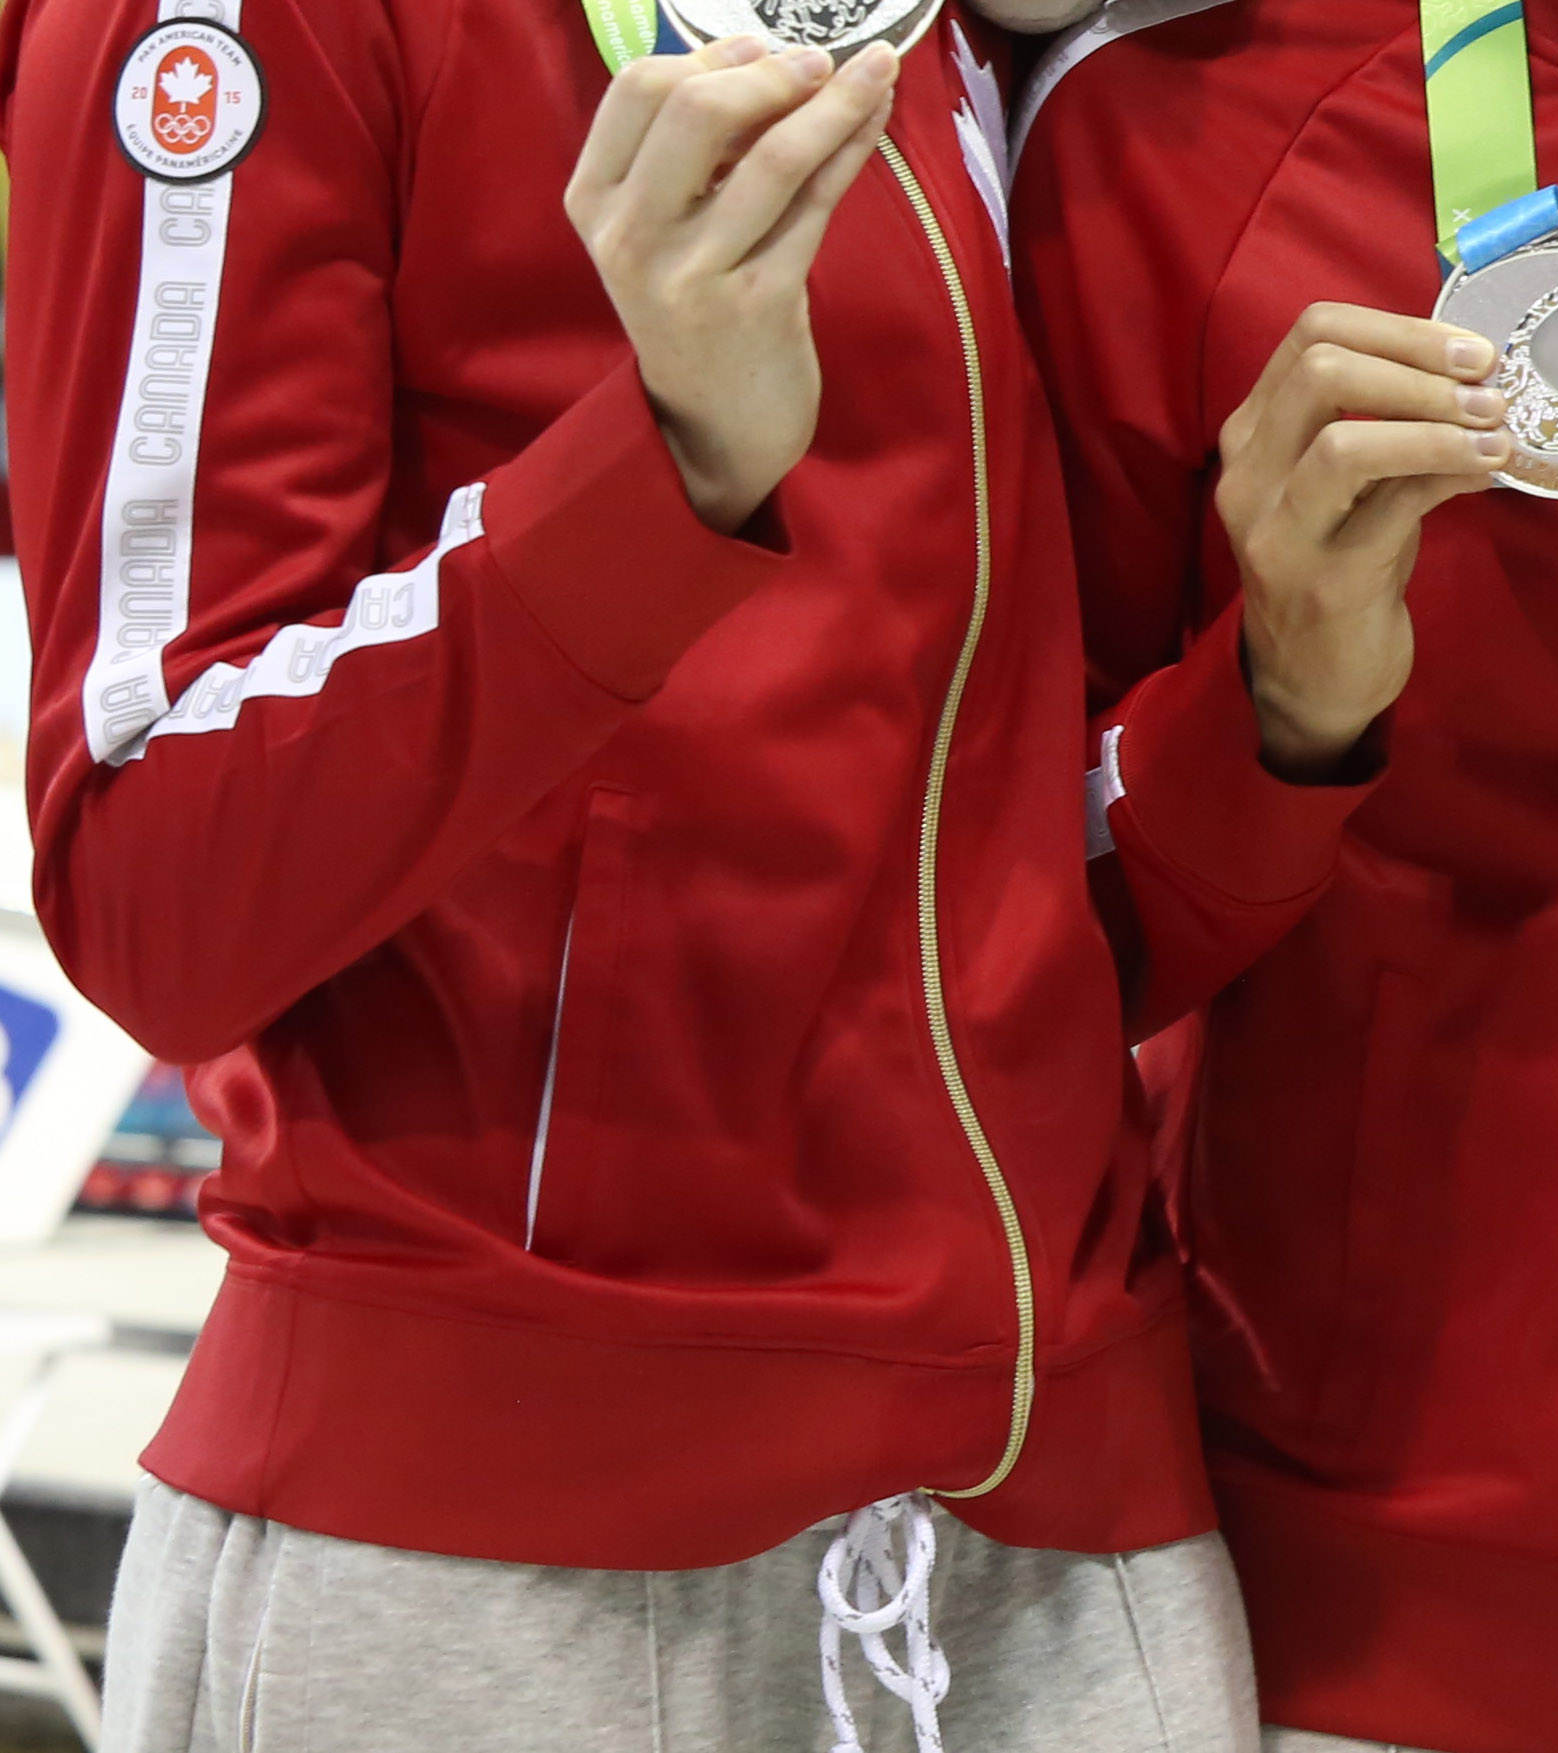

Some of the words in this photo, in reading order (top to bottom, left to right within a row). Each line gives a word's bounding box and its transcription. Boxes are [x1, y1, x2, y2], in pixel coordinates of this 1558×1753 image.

[216, 39, 243, 67] TEAM
[131, 86, 148, 100] 20
[129, 280, 208, 468] CANADA
